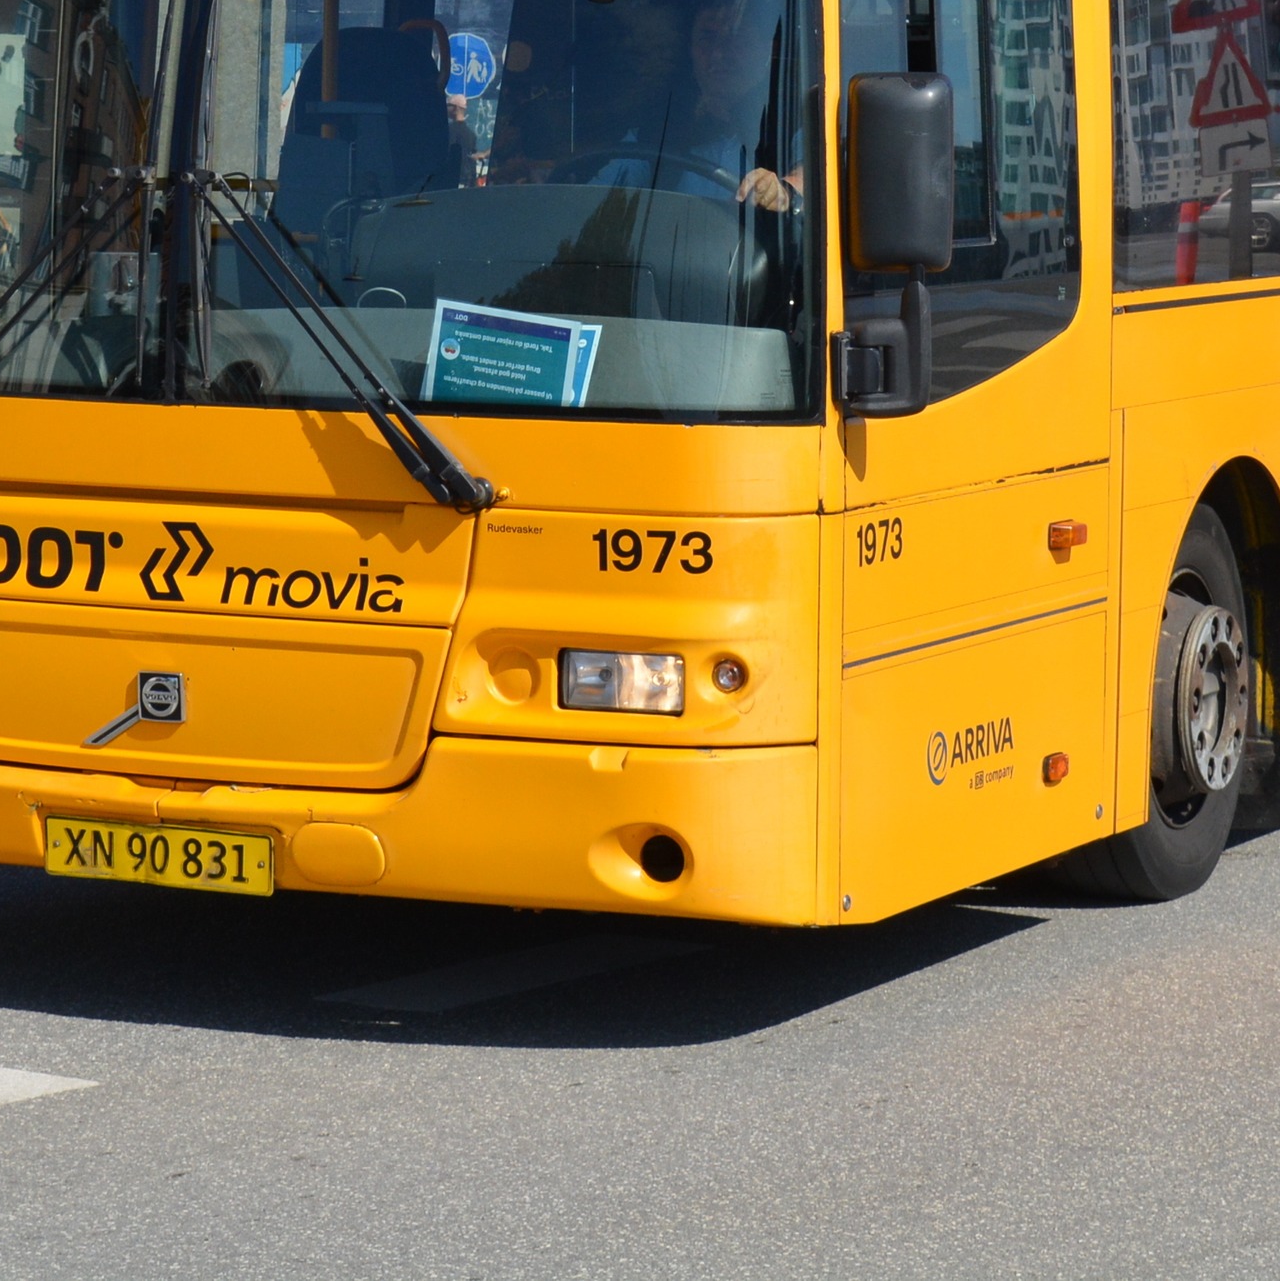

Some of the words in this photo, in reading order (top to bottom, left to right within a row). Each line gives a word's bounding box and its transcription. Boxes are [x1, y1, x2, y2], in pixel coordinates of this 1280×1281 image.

[454, 313, 468, 322] DOT
[487, 522, 544, 536] Rudevasker
[591, 527, 714, 575] 1973
[856, 516, 904, 568] 1973
[220, 557, 406, 613] movia
[144, 693, 177, 702] VOLVO
[950, 717, 1014, 768] ARRIVA
[985, 765, 1014, 784] company
[64, 827, 115, 868] XN
[126, 832, 170, 875] 90
[181, 836, 250, 884] 831
